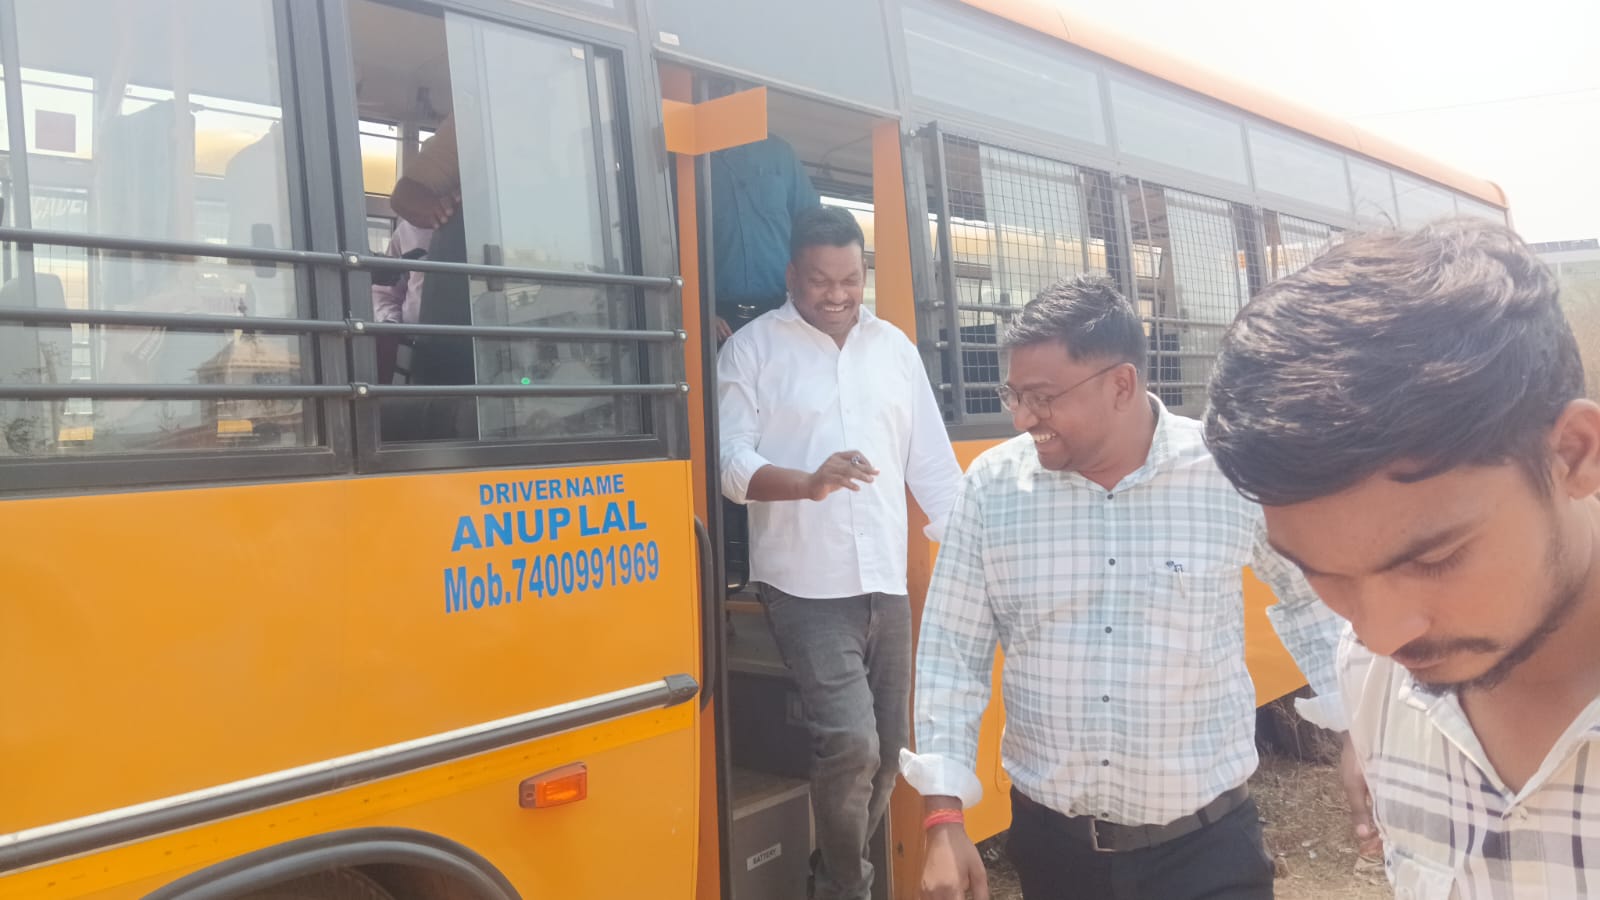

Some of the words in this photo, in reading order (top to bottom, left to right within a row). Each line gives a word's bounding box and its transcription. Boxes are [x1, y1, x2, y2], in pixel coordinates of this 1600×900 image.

[479, 479, 562, 506] DRIVER
[566, 474, 625, 498] NAME
[451, 507, 571, 552] ANUP
[578, 500, 648, 537] LAL
[444, 540, 659, 614] Mob.7400991969
